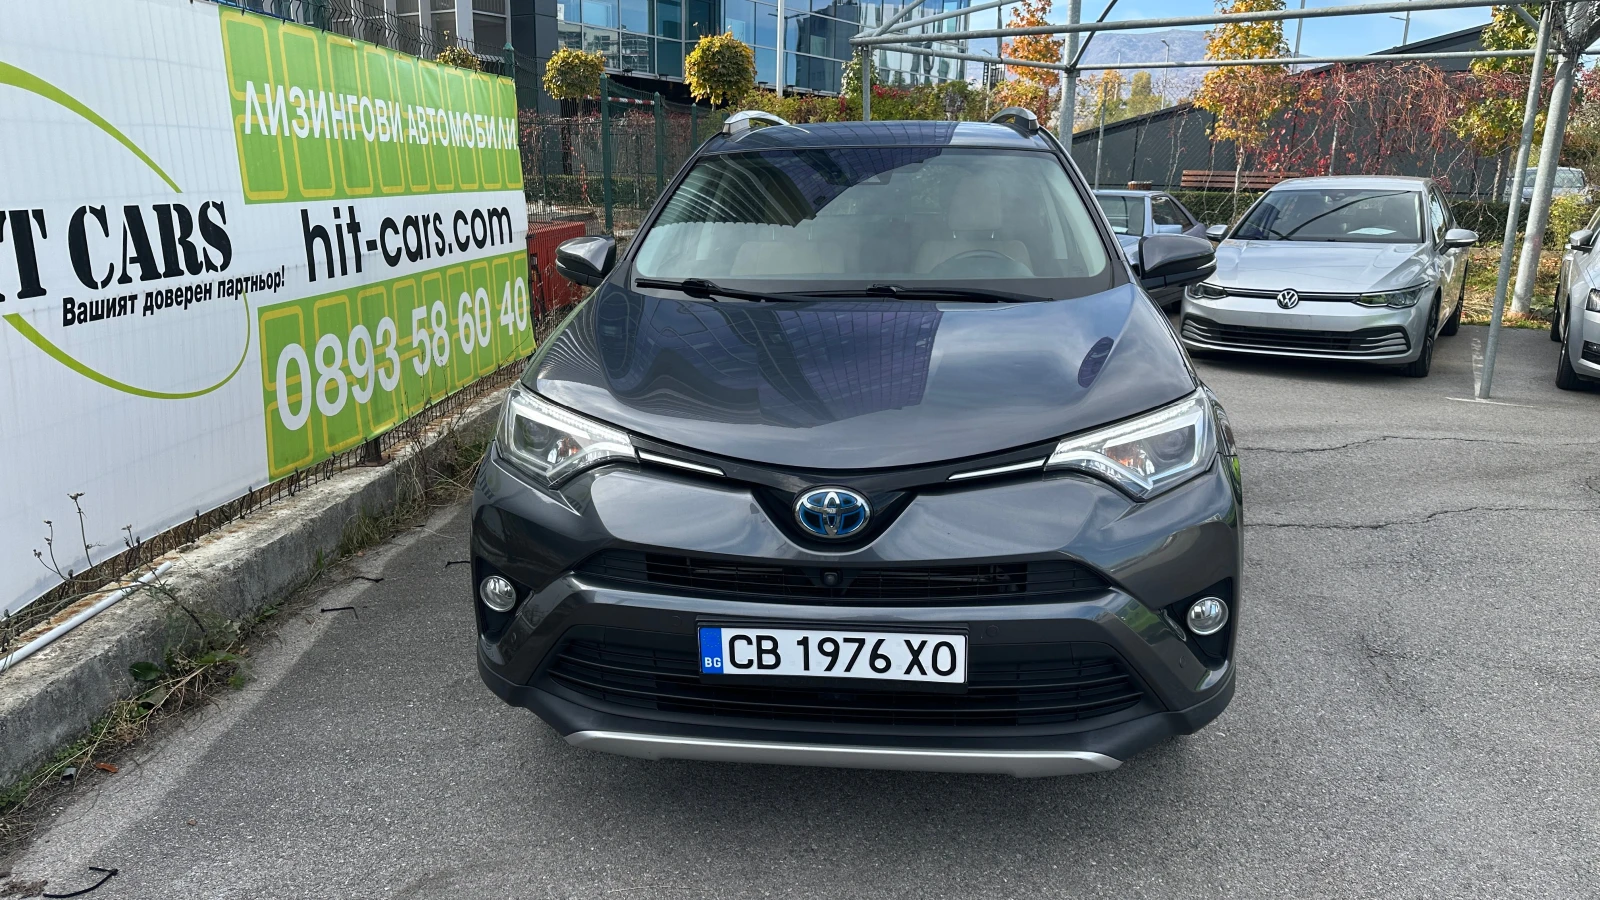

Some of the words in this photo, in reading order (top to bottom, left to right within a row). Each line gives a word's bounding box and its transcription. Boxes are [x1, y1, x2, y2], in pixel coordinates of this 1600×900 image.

[244, 80, 404, 143] ЛИЗИНГОВИ
[407, 104, 518, 150] АВТОМОБИЛИ
[0, 208, 47, 300] T
[68, 200, 233, 290] CARS
[301, 205, 513, 282] hit-cars.com
[62, 293, 138, 327] Вашият
[142, 281, 212, 317] доверен
[217, 265, 285, 302] партньор!
[276, 316, 400, 431] 0893
[412, 300, 450, 376] 58
[458, 287, 491, 354] 60
[500, 277, 527, 336] 40
[704, 656, 722, 668] BG
[728, 634, 781, 670] CB
[796, 636, 892, 674] 1976
[903, 639, 957, 676] XO
